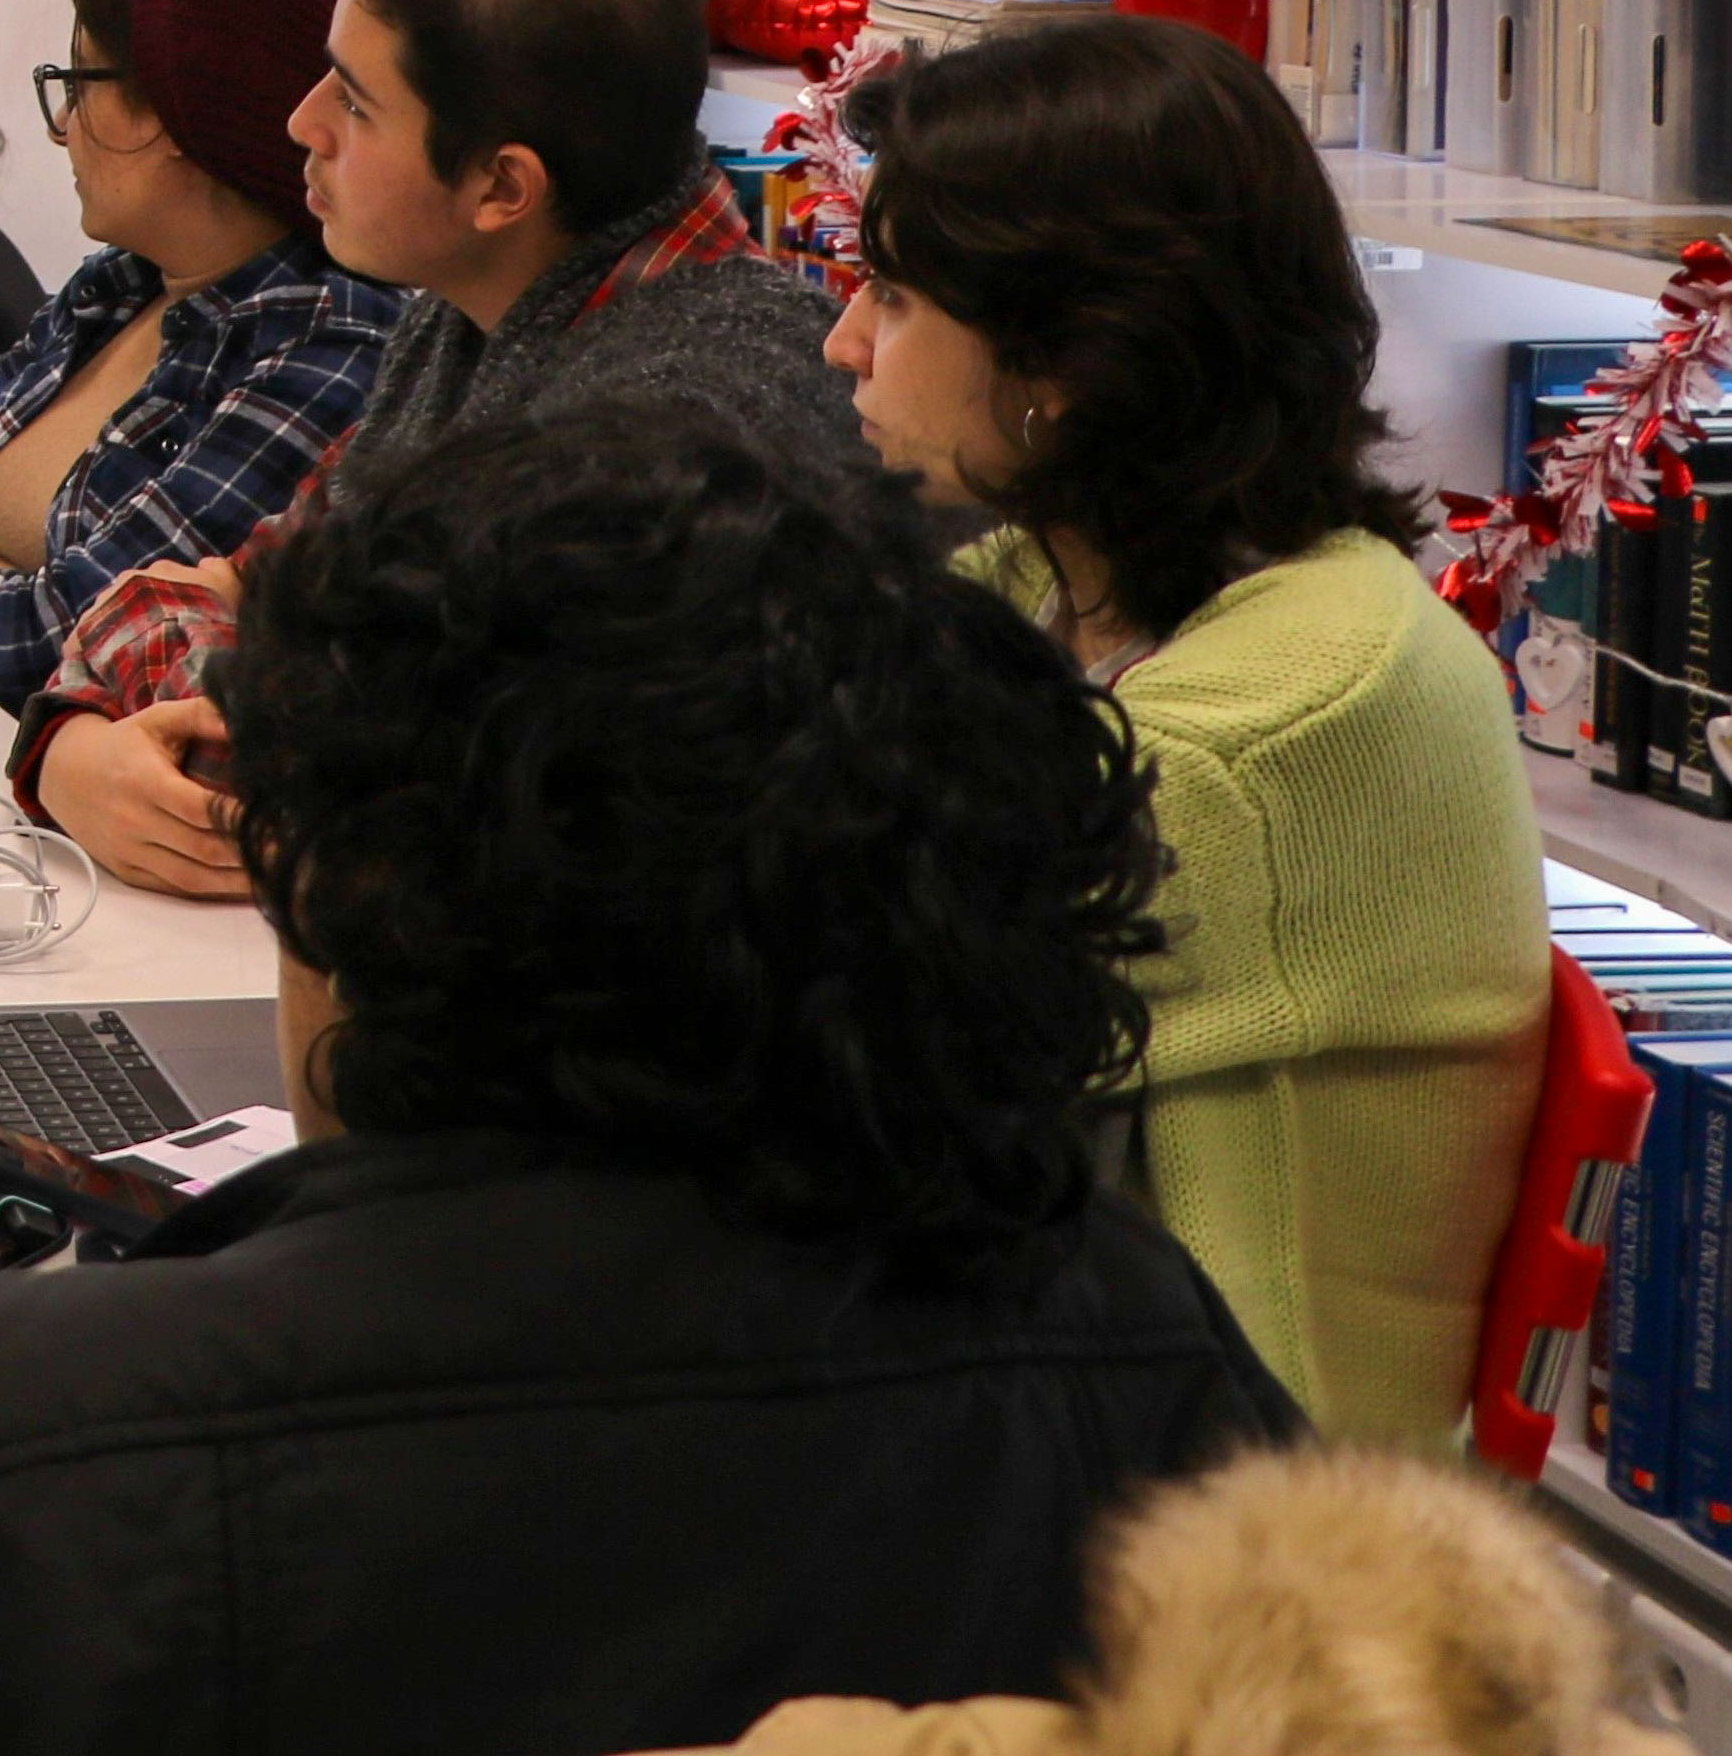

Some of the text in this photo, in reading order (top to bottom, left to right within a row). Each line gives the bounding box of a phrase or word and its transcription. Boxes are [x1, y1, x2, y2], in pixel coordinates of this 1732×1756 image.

[1616, 1196, 1641, 1354] ENCYCLOPEDIA
[1694, 1109, 1728, 1391] SCIENTIFIC ENCYCLOPEDIA
